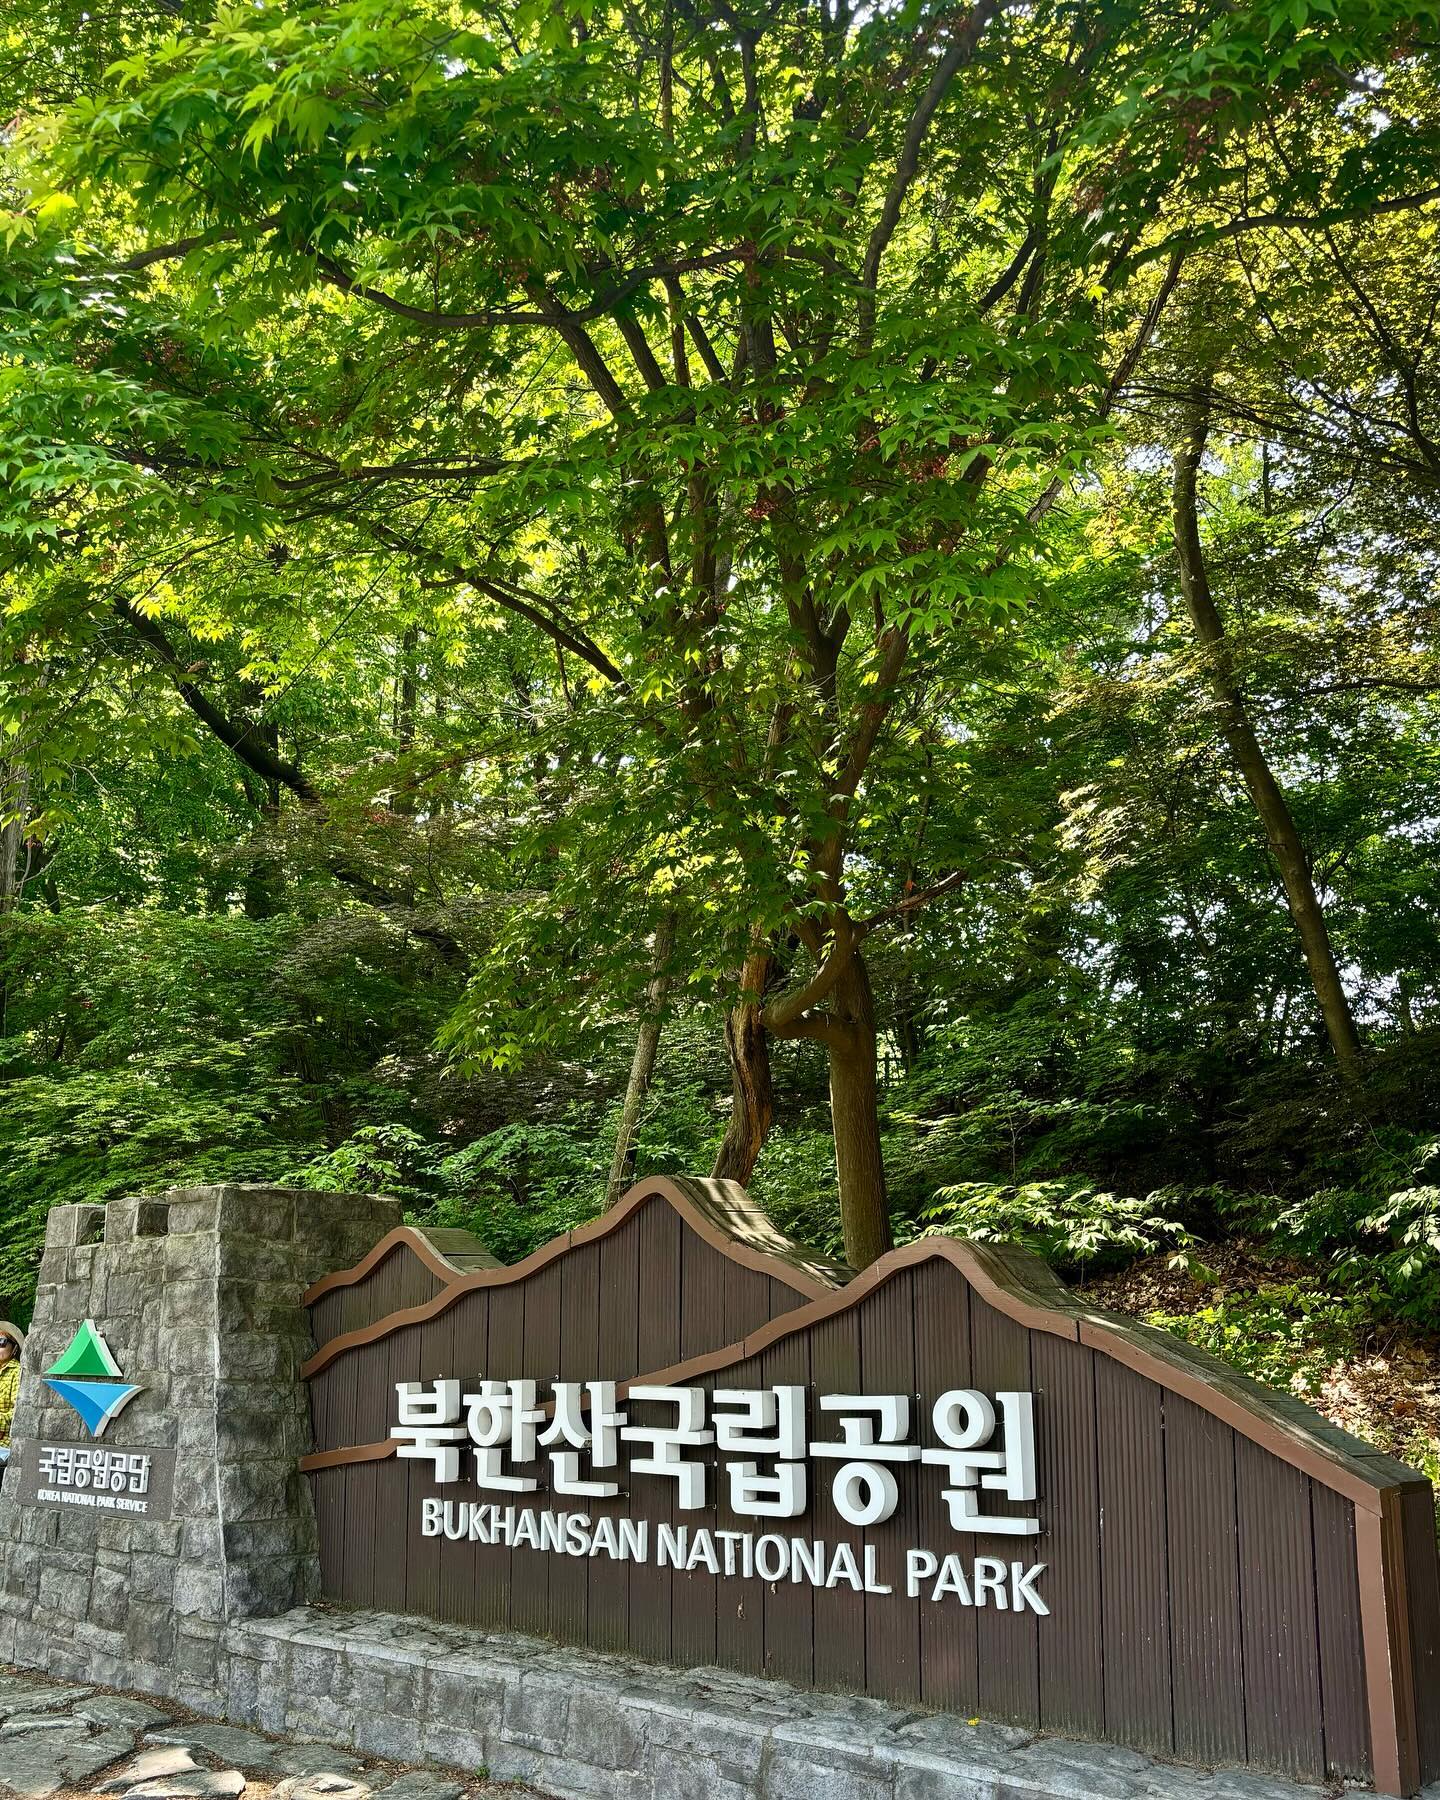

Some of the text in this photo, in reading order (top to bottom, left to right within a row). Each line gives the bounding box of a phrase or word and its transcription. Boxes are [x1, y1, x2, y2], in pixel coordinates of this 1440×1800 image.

[39, 1447, 152, 1493] 국립공원공단
[391, 1379, 1040, 1535] 북한산국립공원
[37, 1489, 148, 1512] KOREA NATIONAL PARK SERVICE
[422, 1498, 1050, 1616] BUKHANSAN NATIONAL PARK
